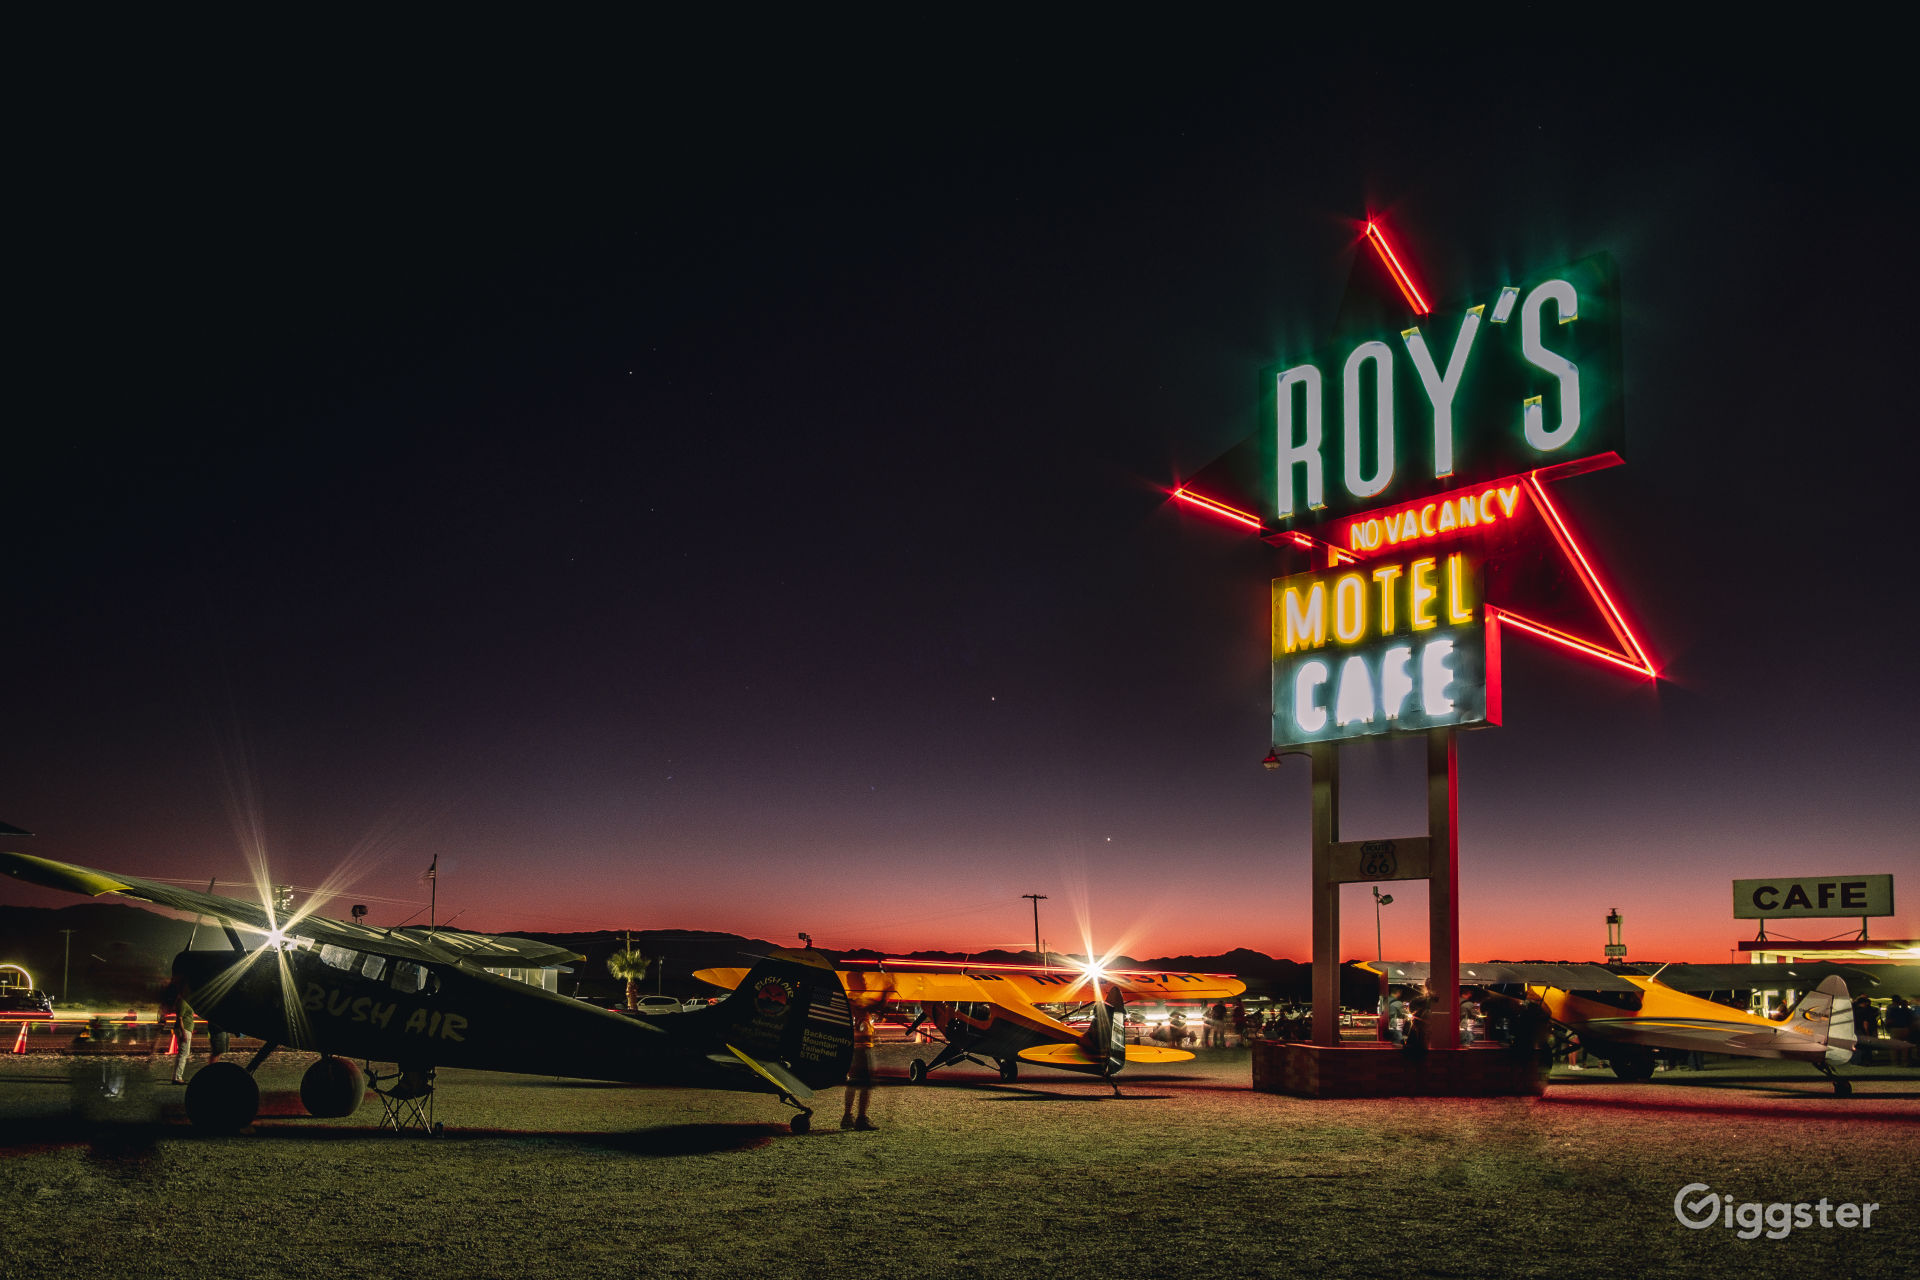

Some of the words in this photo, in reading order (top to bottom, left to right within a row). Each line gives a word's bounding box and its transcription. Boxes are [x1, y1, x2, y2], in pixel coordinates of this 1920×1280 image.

[1277, 279, 1581, 519] ROY'S
[1351, 519, 1380, 551] NO
[1384, 484, 1519, 545] VACANCY
[1284, 551, 1473, 653] MOTEL
[1295, 639, 1455, 733] CAFE
[1367, 858, 1389, 874] 66
[1752, 882, 1868, 910] CAFE
[754, 976, 782, 991] BUSH
[301, 982, 397, 1030] BUSH
[404, 1008, 469, 1042] AIR
[802, 1036, 838, 1049] Mountain
[804, 1028, 853, 1047] Backcountry
